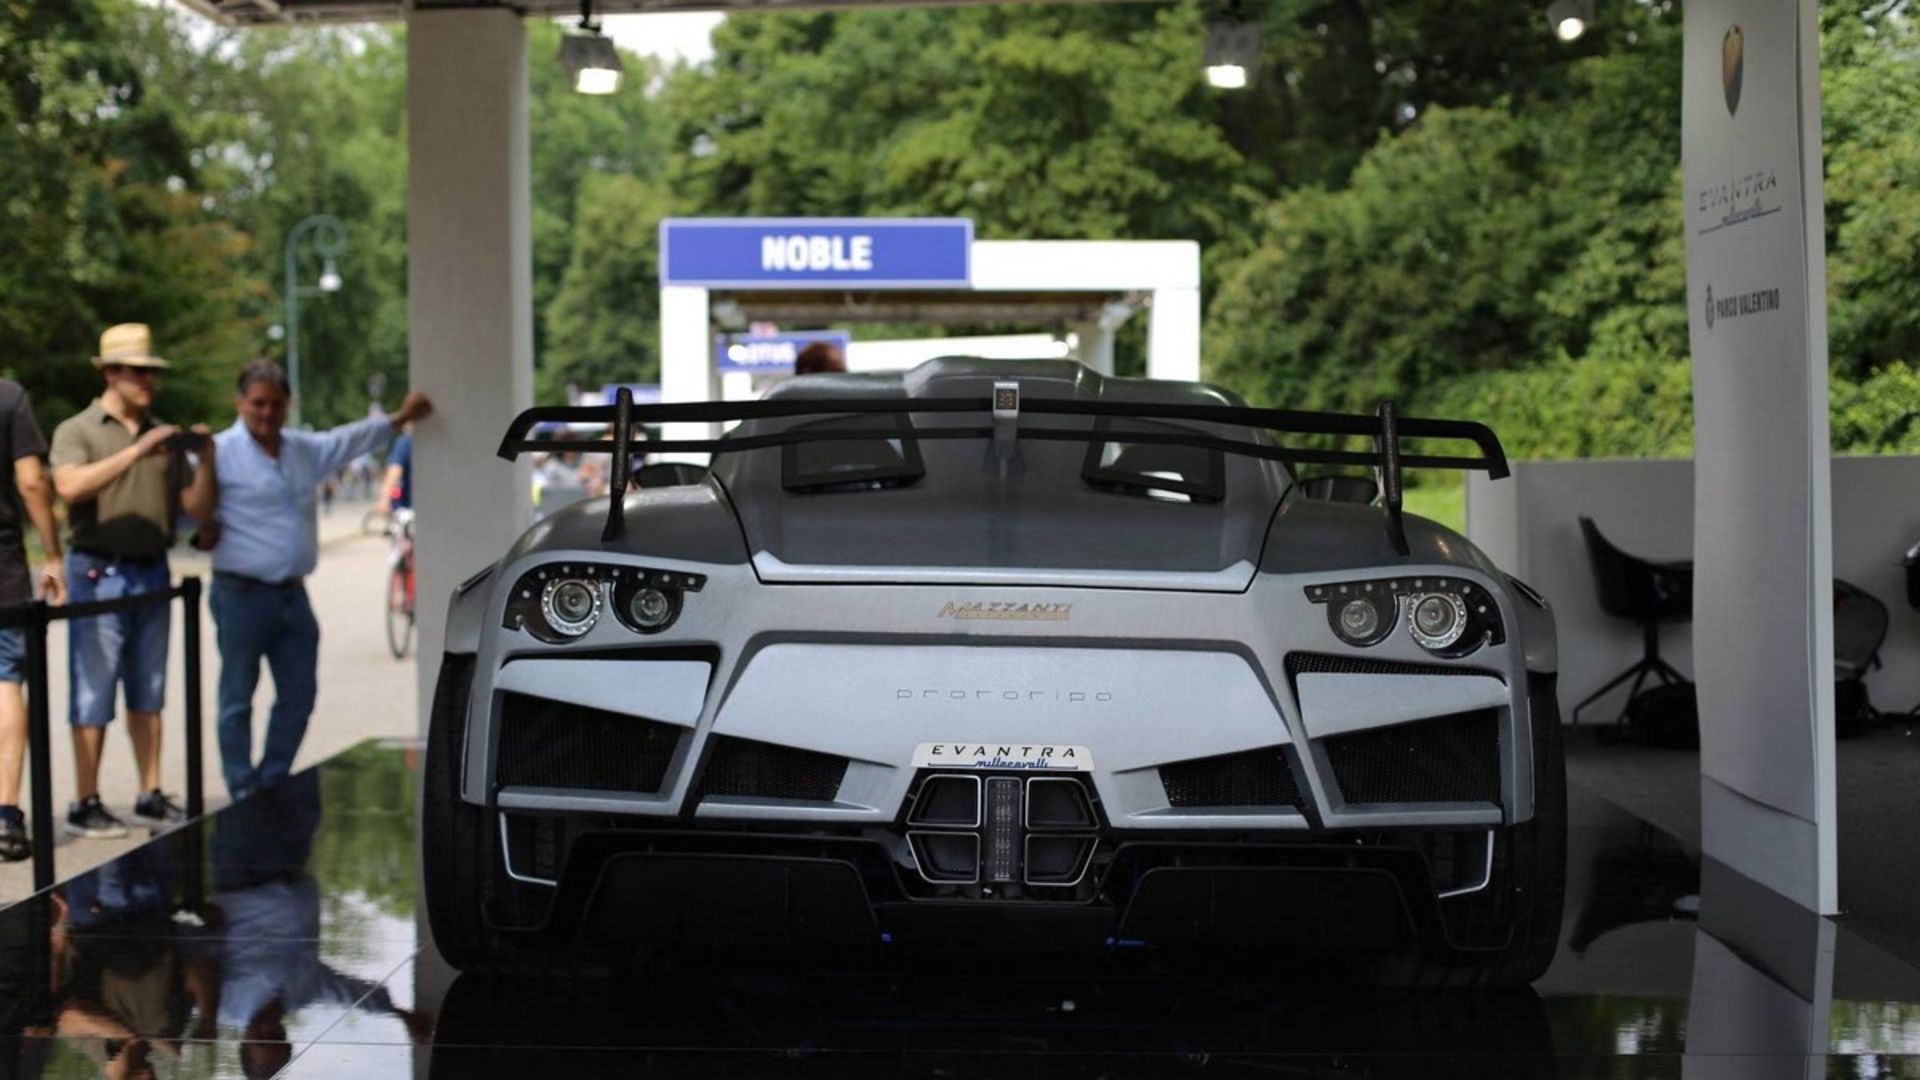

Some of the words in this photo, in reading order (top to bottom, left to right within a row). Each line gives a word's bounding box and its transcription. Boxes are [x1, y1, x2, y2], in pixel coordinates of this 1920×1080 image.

[1699, 171, 1777, 212] EVANTRA
[761, 235, 874, 271] NOBLE
[1716, 296, 1737, 320] PARCO
[1739, 288, 1779, 315] VALENTINO
[937, 600, 1073, 619] MAZZANTI
[931, 745, 1075, 757] EVANTRA
